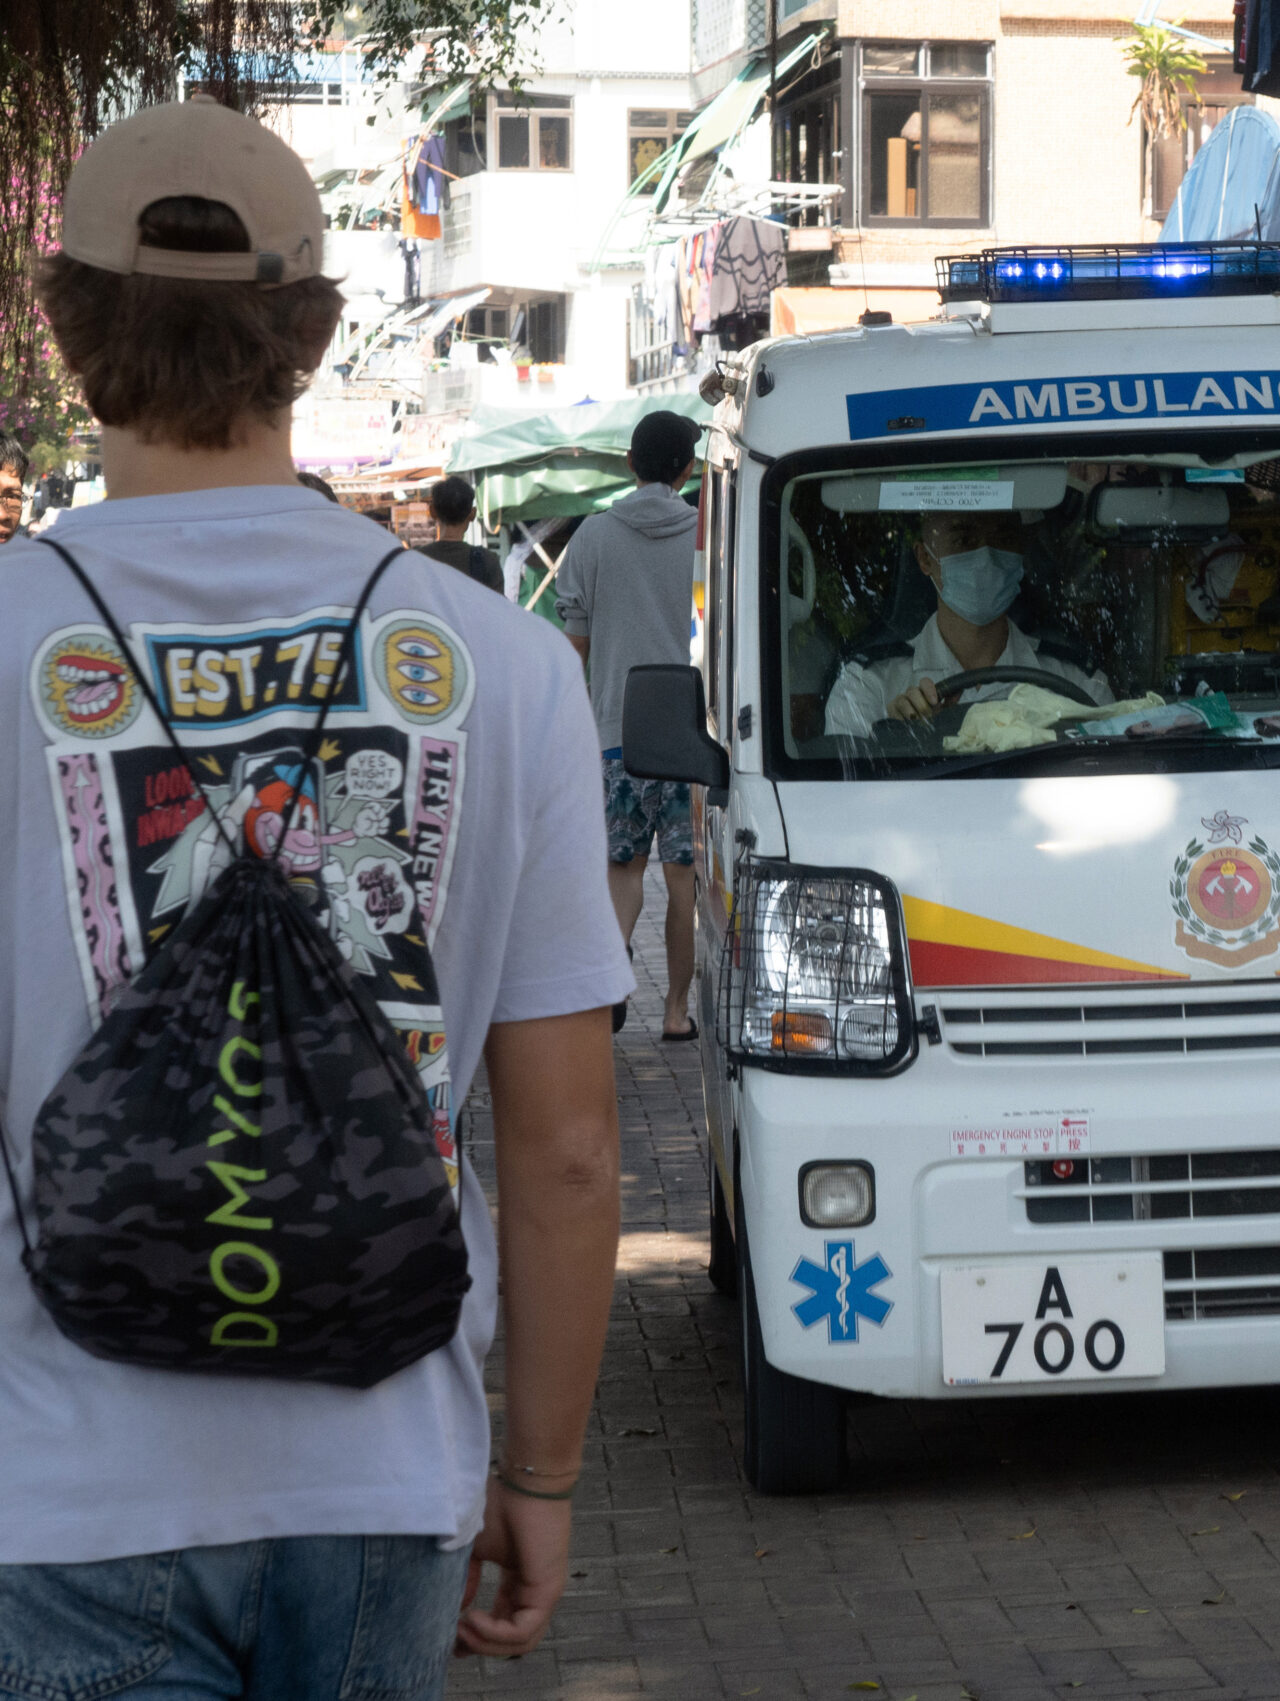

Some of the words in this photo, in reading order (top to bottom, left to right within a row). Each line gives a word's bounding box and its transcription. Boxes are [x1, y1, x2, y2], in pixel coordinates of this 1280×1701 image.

[350, 767, 396, 779] RIGHT
[357, 755, 387, 768] YES
[421, 748, 452, 822] TRY
[412, 822, 443, 908] NEW
[952, 1128, 1000, 1142] EMERGENCY
[1002, 1127, 1032, 1140] ENGINE
[1034, 1126, 1054, 1139] STOP
[1060, 1126, 1088, 1137] PRESS
[1035, 1266, 1074, 1320] A
[984, 1318, 1126, 1378] 700
